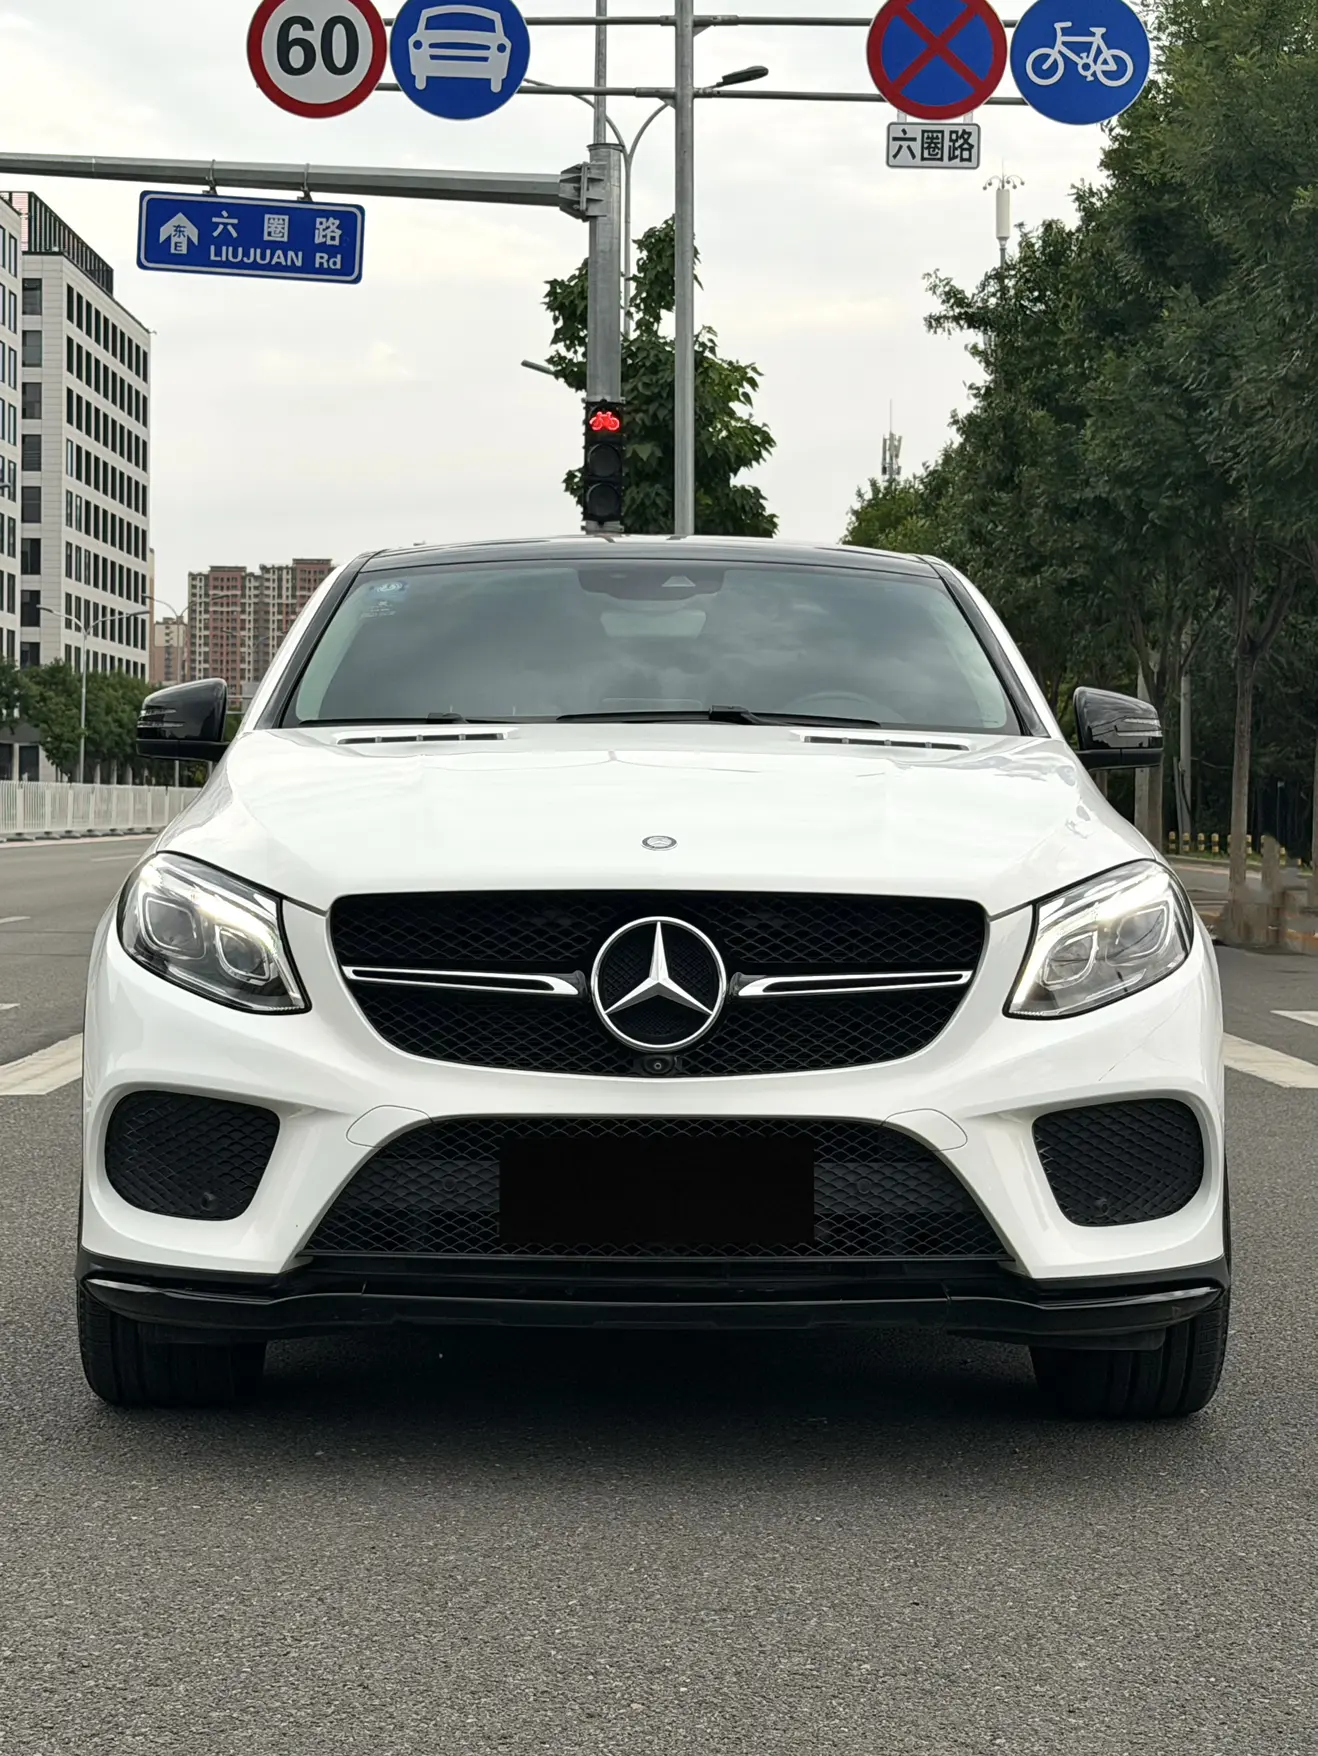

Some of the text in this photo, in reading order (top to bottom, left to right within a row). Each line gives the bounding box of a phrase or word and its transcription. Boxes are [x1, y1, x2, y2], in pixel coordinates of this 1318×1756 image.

[276, 15, 360, 76] 60
[891, 128, 975, 162] 六圈路
[172, 224, 187, 238] 东
[211, 210, 343, 246] 六圈路
[174, 241, 183, 252] E
[210, 244, 342, 270] LIUJUAN Rd
